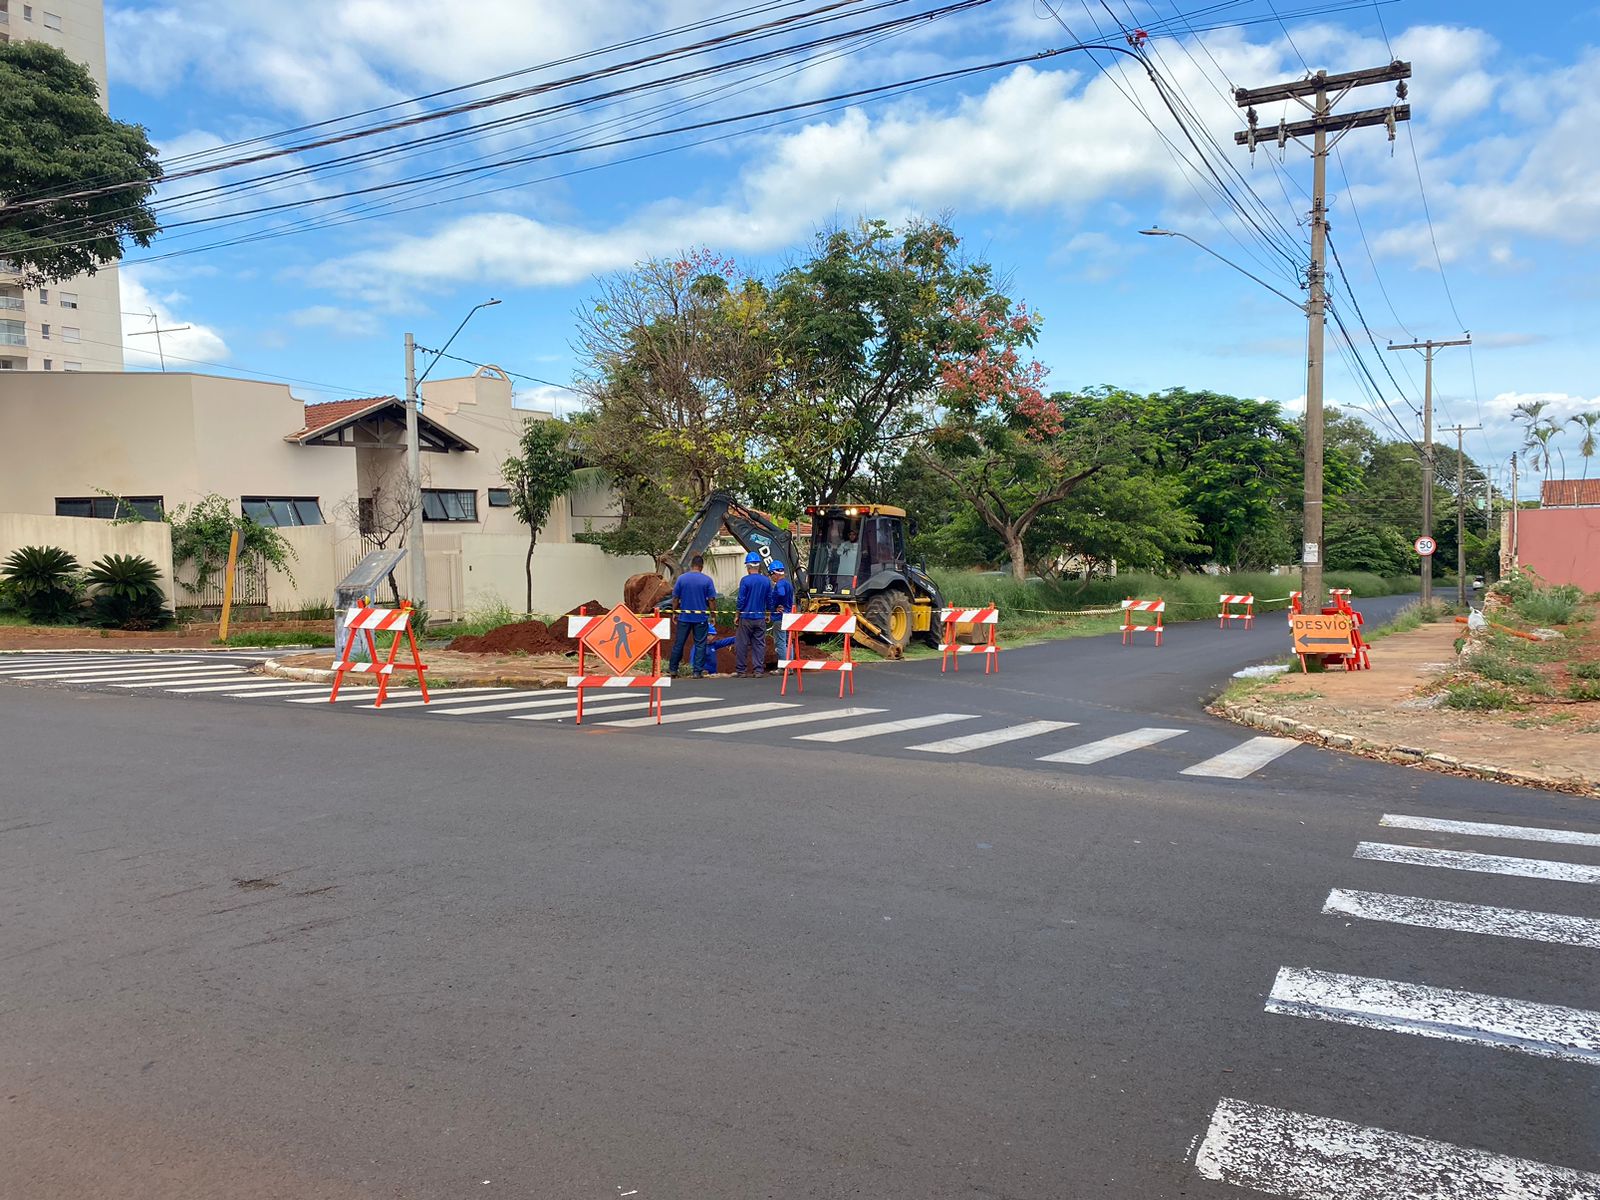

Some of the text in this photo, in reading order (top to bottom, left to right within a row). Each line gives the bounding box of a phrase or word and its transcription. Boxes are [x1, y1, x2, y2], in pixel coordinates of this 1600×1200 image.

[1420, 540, 1432, 549] 50
[759, 545, 774, 570] DE
[1295, 620, 1347, 630] DESVIO
